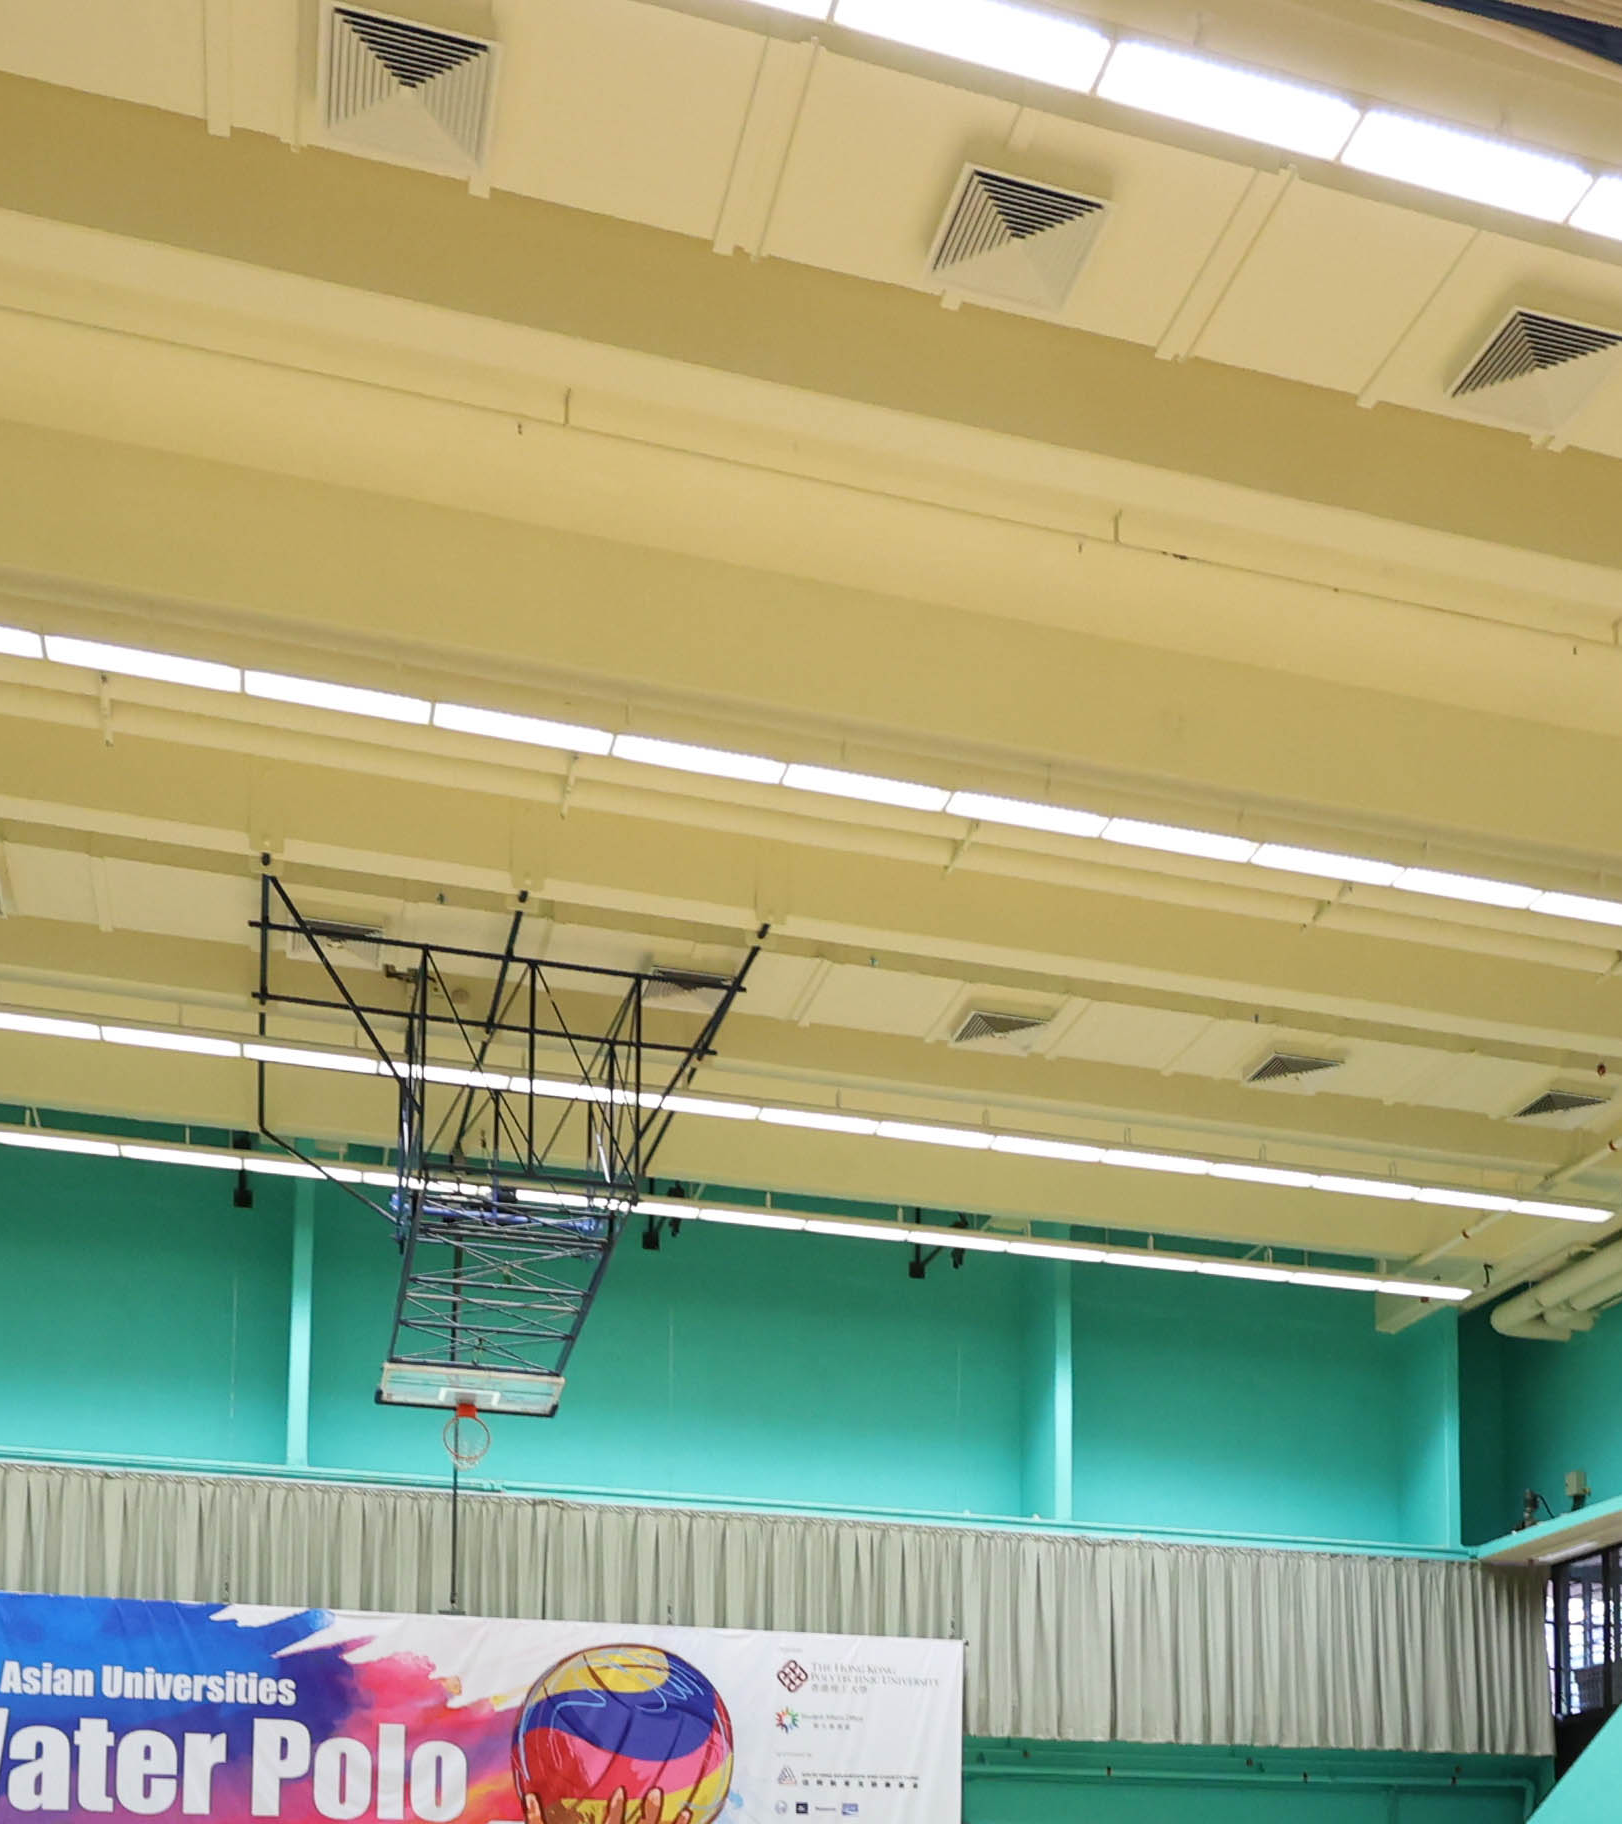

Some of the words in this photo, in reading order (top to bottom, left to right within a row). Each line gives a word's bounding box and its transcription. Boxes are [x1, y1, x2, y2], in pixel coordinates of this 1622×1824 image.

[0, 1660, 95, 1697] Asian
[101, 1665, 297, 1706] Universities
[251, 1717, 468, 1821] Polo
